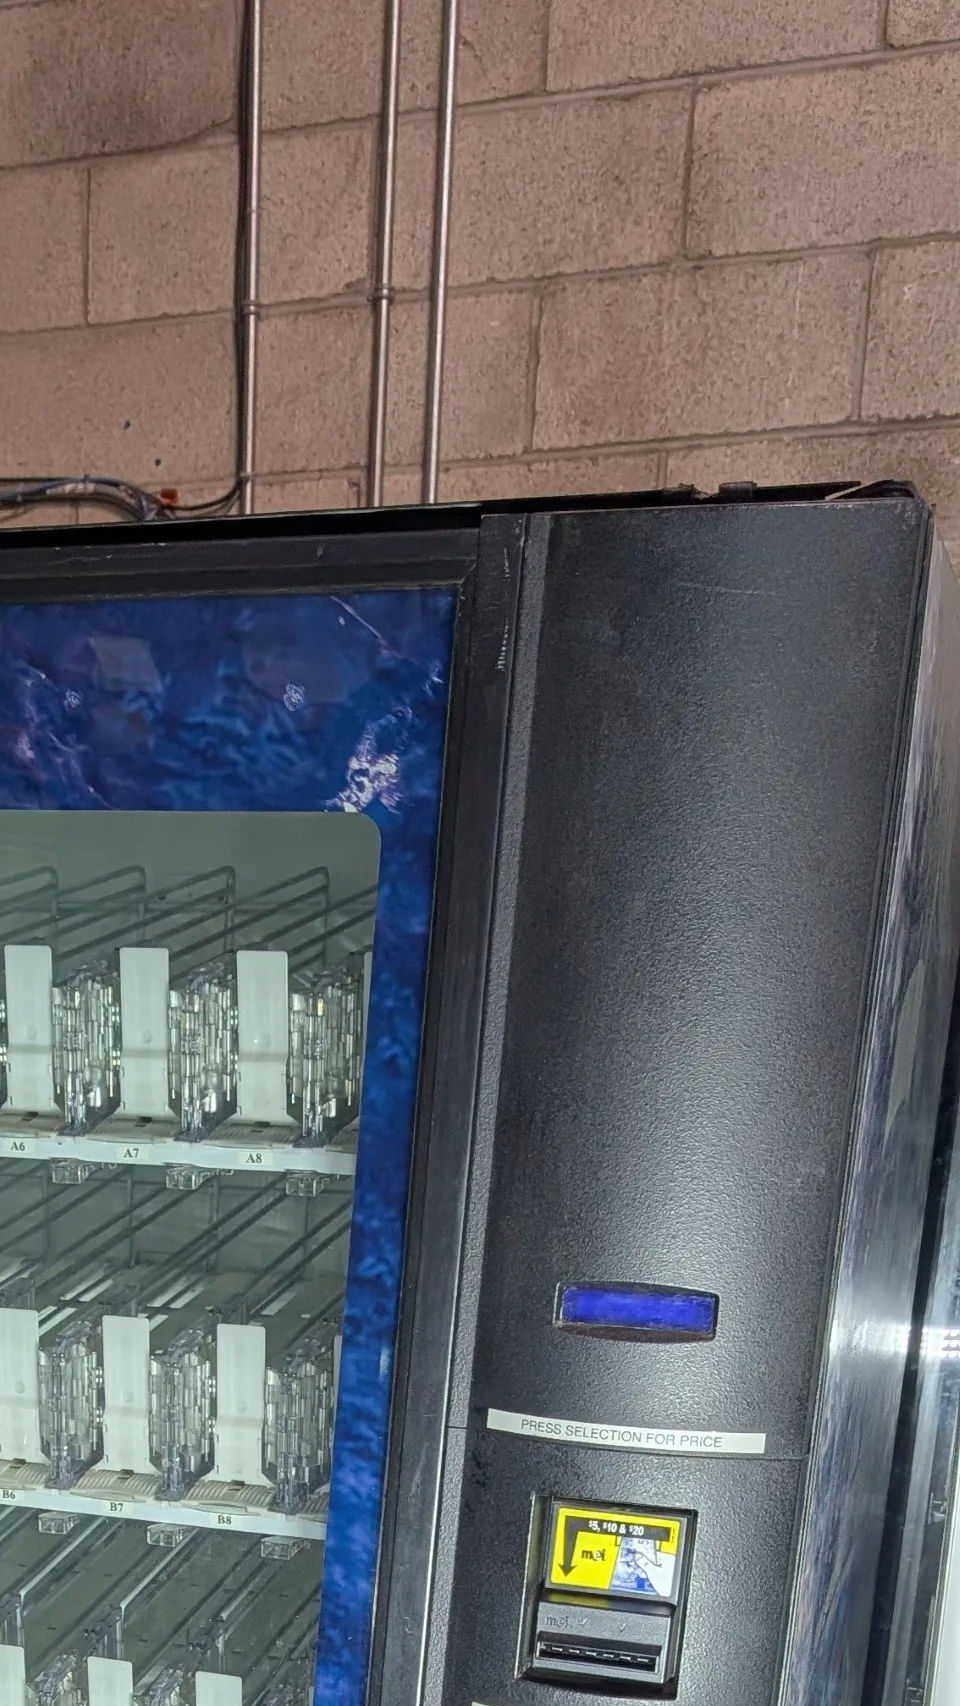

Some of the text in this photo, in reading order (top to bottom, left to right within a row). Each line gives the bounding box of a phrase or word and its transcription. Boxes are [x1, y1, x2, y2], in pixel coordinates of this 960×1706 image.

[10, 1140, 26, 1152] A6
[123, 1147, 140, 1159] A7
[246, 1152, 263, 1164] A8
[521, 1418, 722, 1449] PRESS SELECTION FOR PRICE
[2, 1489, 16, 1500] B6
[109, 1502, 124, 1513] B7
[217, 1514, 232, 1526] B8
[589, 1520, 644, 1535] $5, $10 & $20
[581, 1548, 606, 1561] mei
